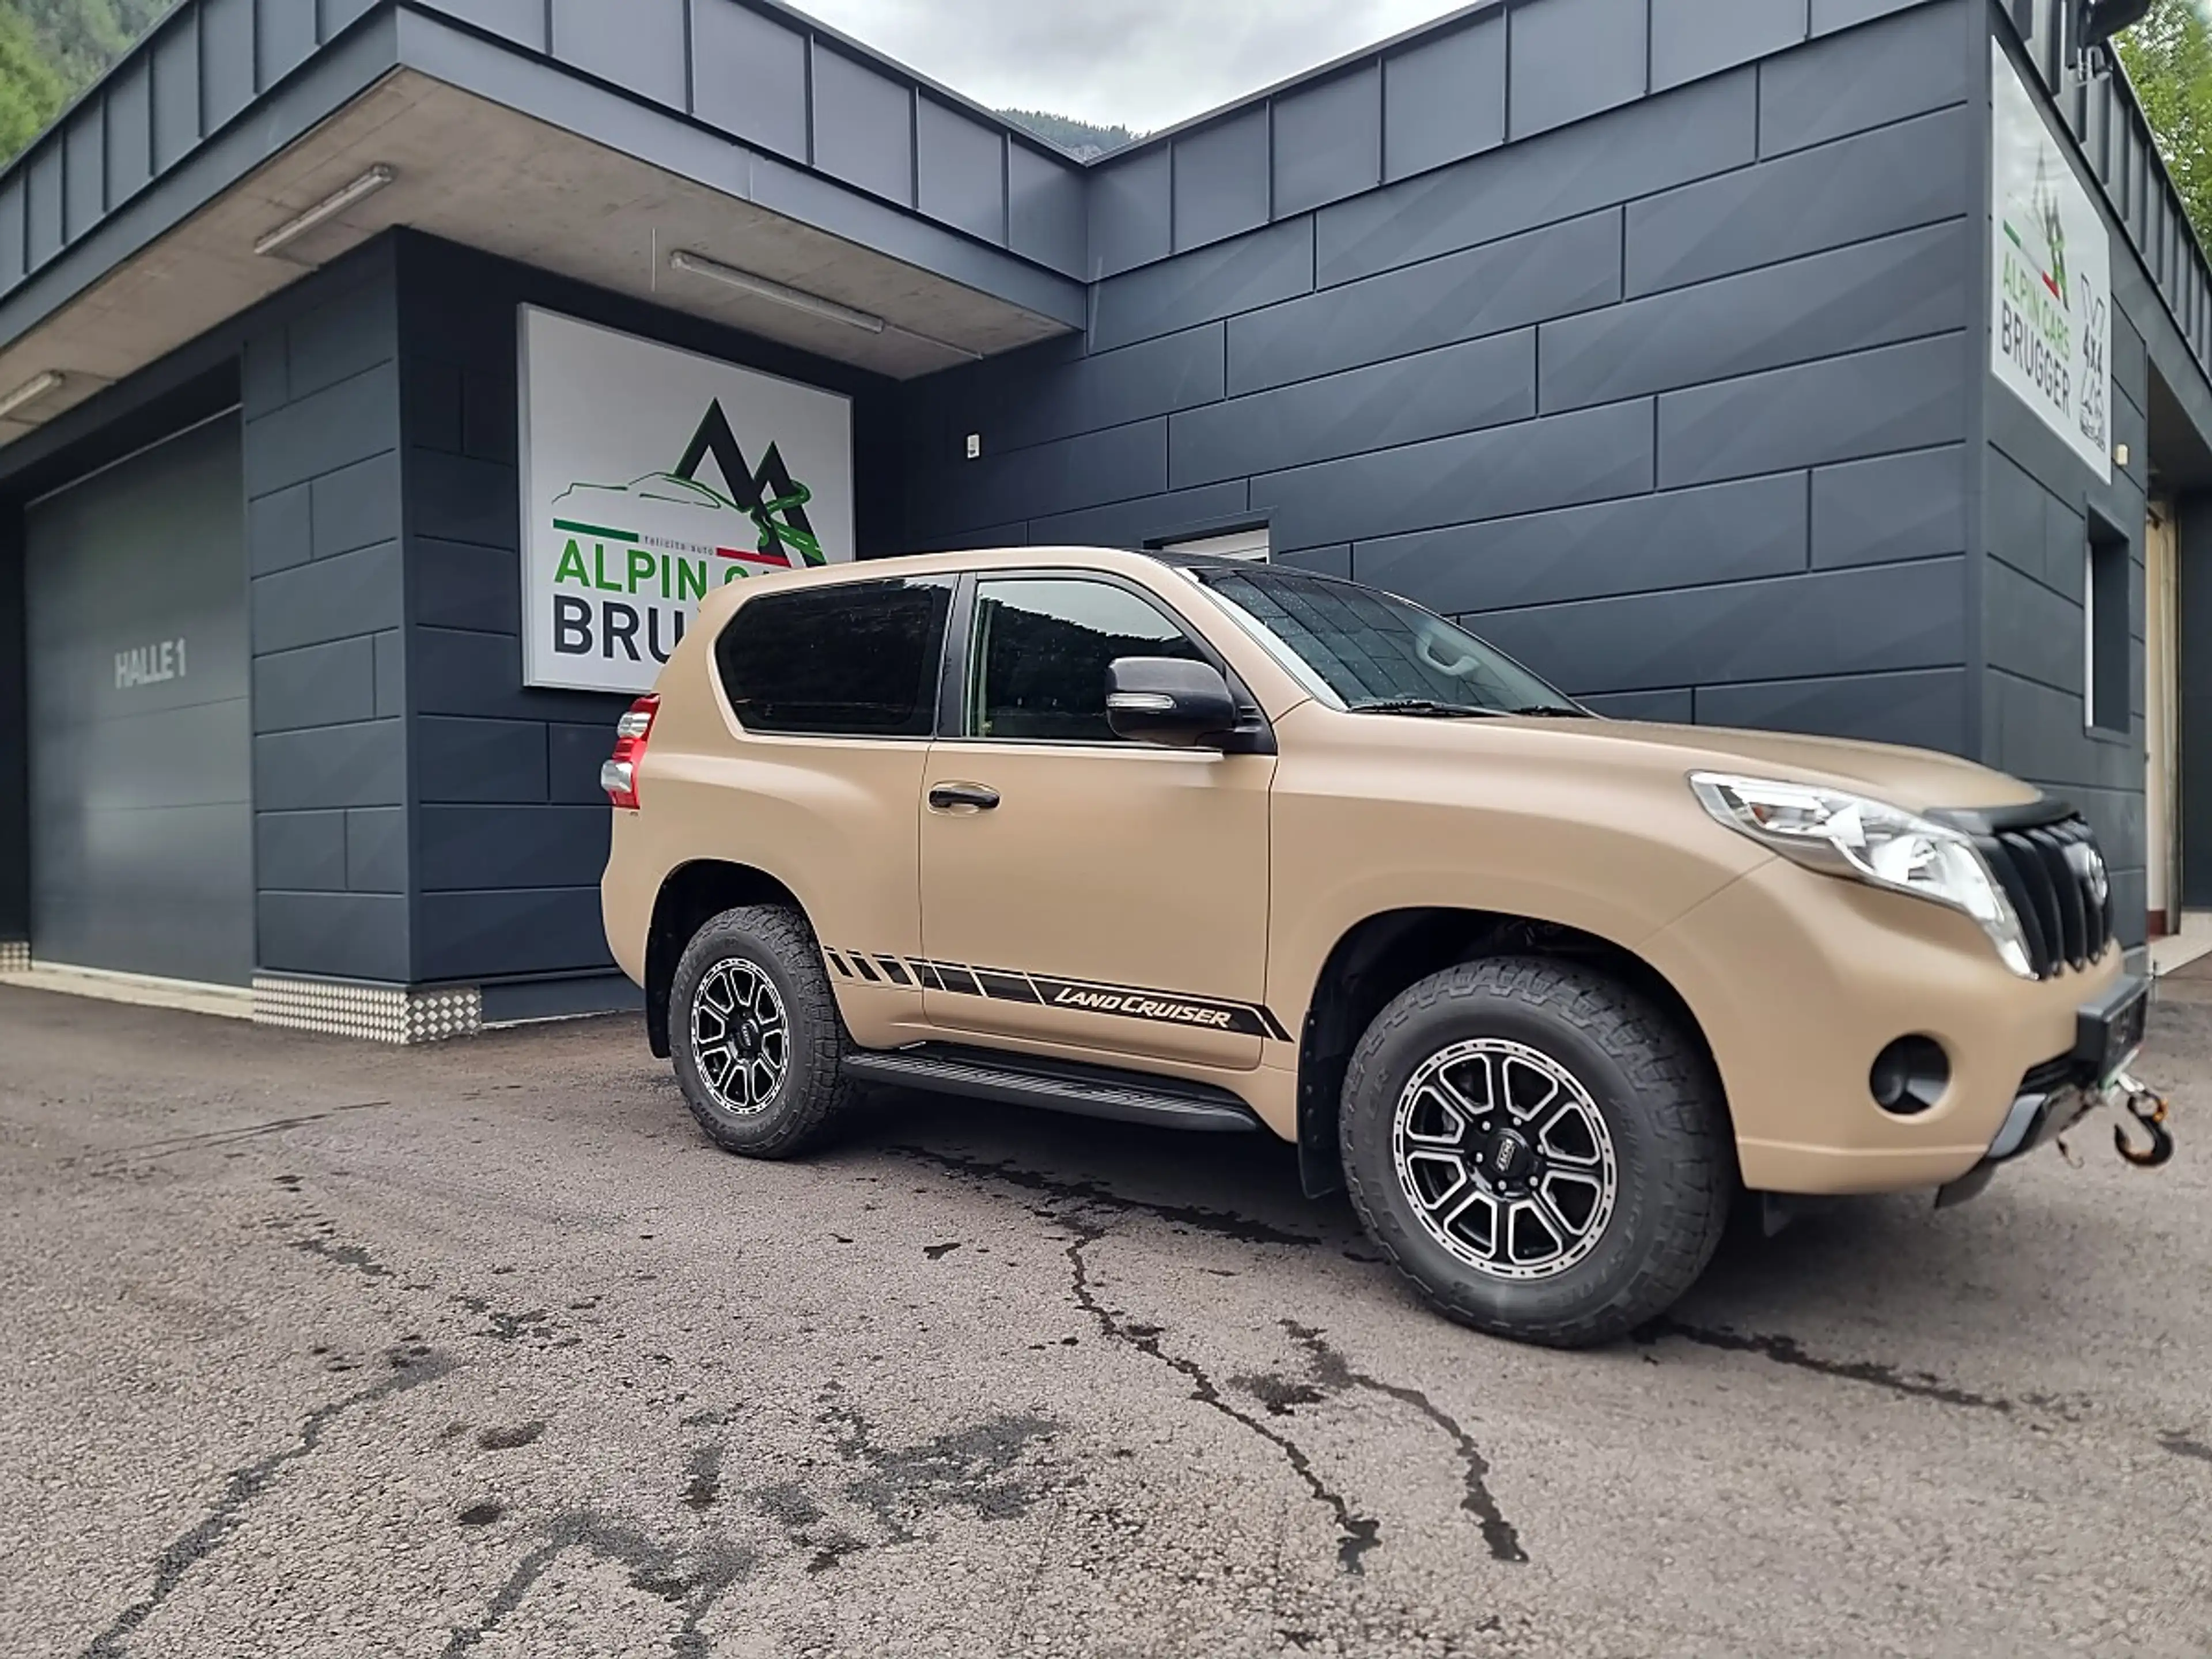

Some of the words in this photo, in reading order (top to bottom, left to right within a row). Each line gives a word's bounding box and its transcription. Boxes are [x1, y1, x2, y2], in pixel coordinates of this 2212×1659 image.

[2003, 252, 2040, 327] ALPIN
[2044, 300, 2070, 362] CARS
[2002, 298, 2071, 419] BRUGGER
[555, 539, 707, 601] ALPIN
[115, 641, 173, 689] HALLE
[175, 637, 186, 676] 1
